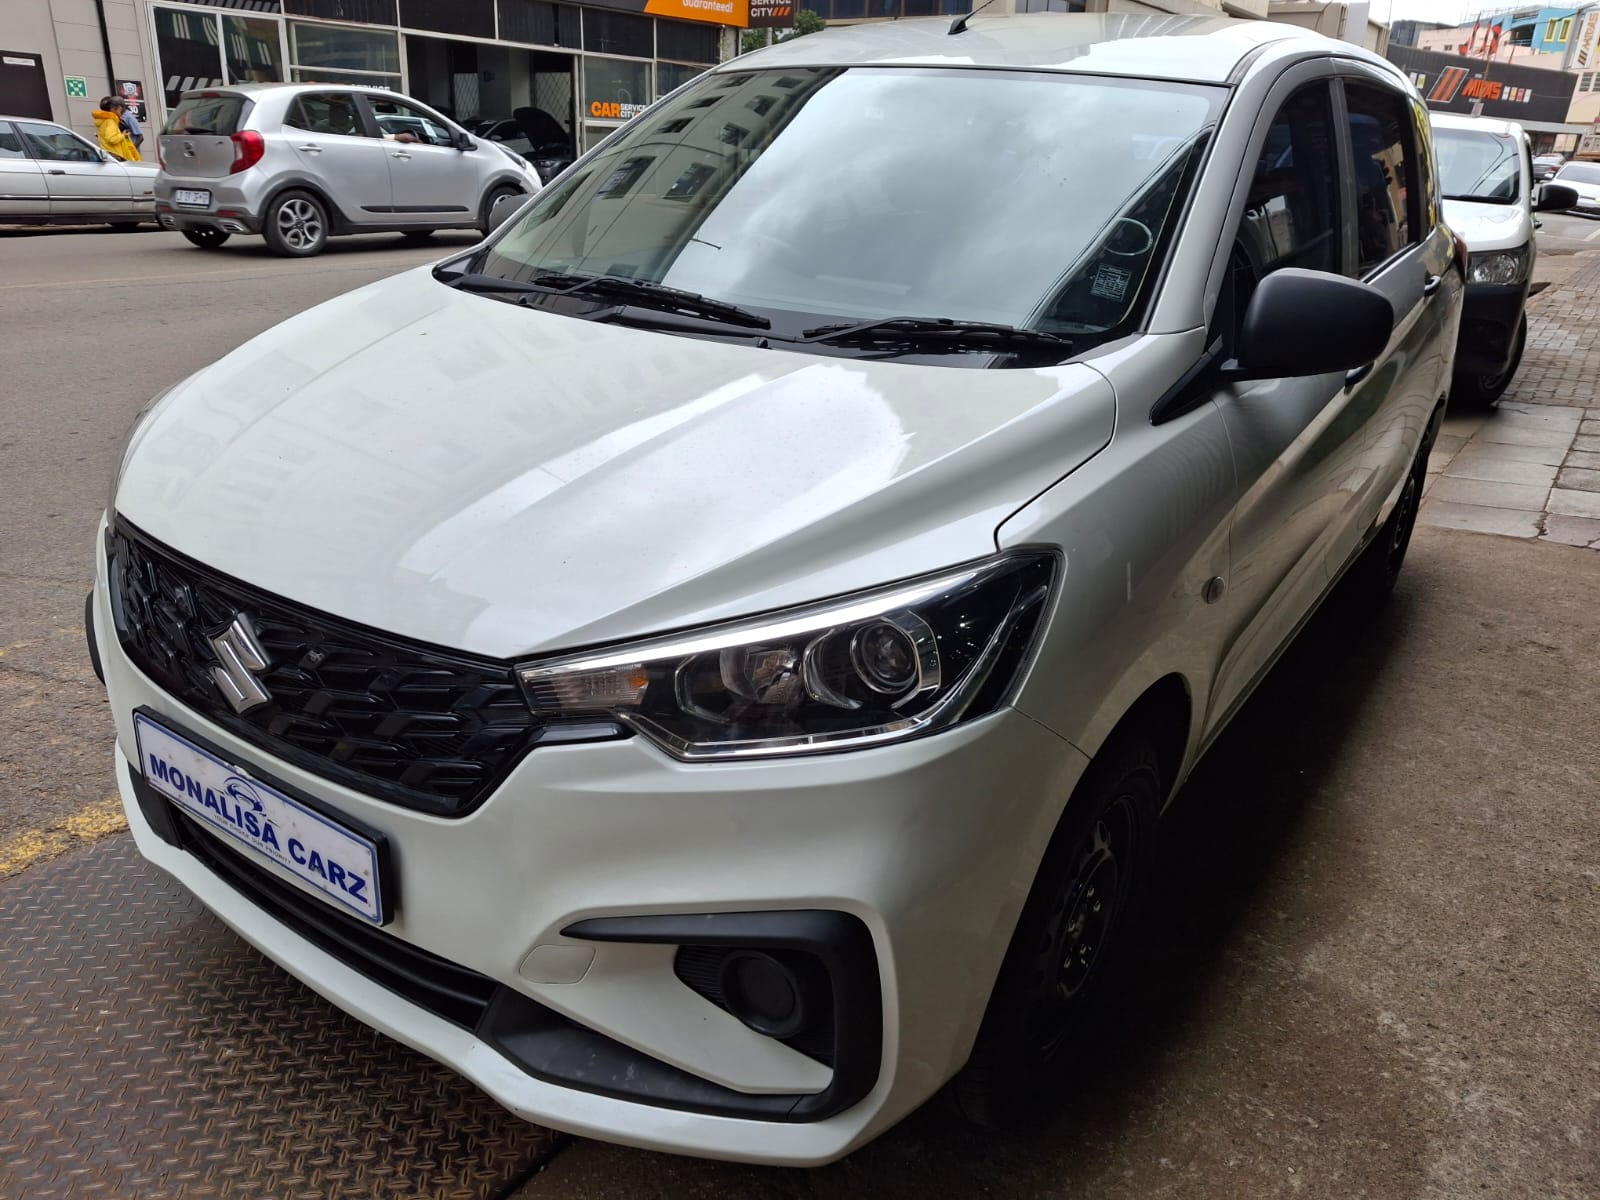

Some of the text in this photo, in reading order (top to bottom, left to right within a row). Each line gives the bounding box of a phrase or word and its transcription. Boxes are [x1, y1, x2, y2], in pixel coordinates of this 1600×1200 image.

[682, 0, 733, 13] Guaranteed!
[751, 7, 773, 17] CITY
[591, 101, 620, 117] CAR
[150, 753, 369, 905] MONALISA CARZ
